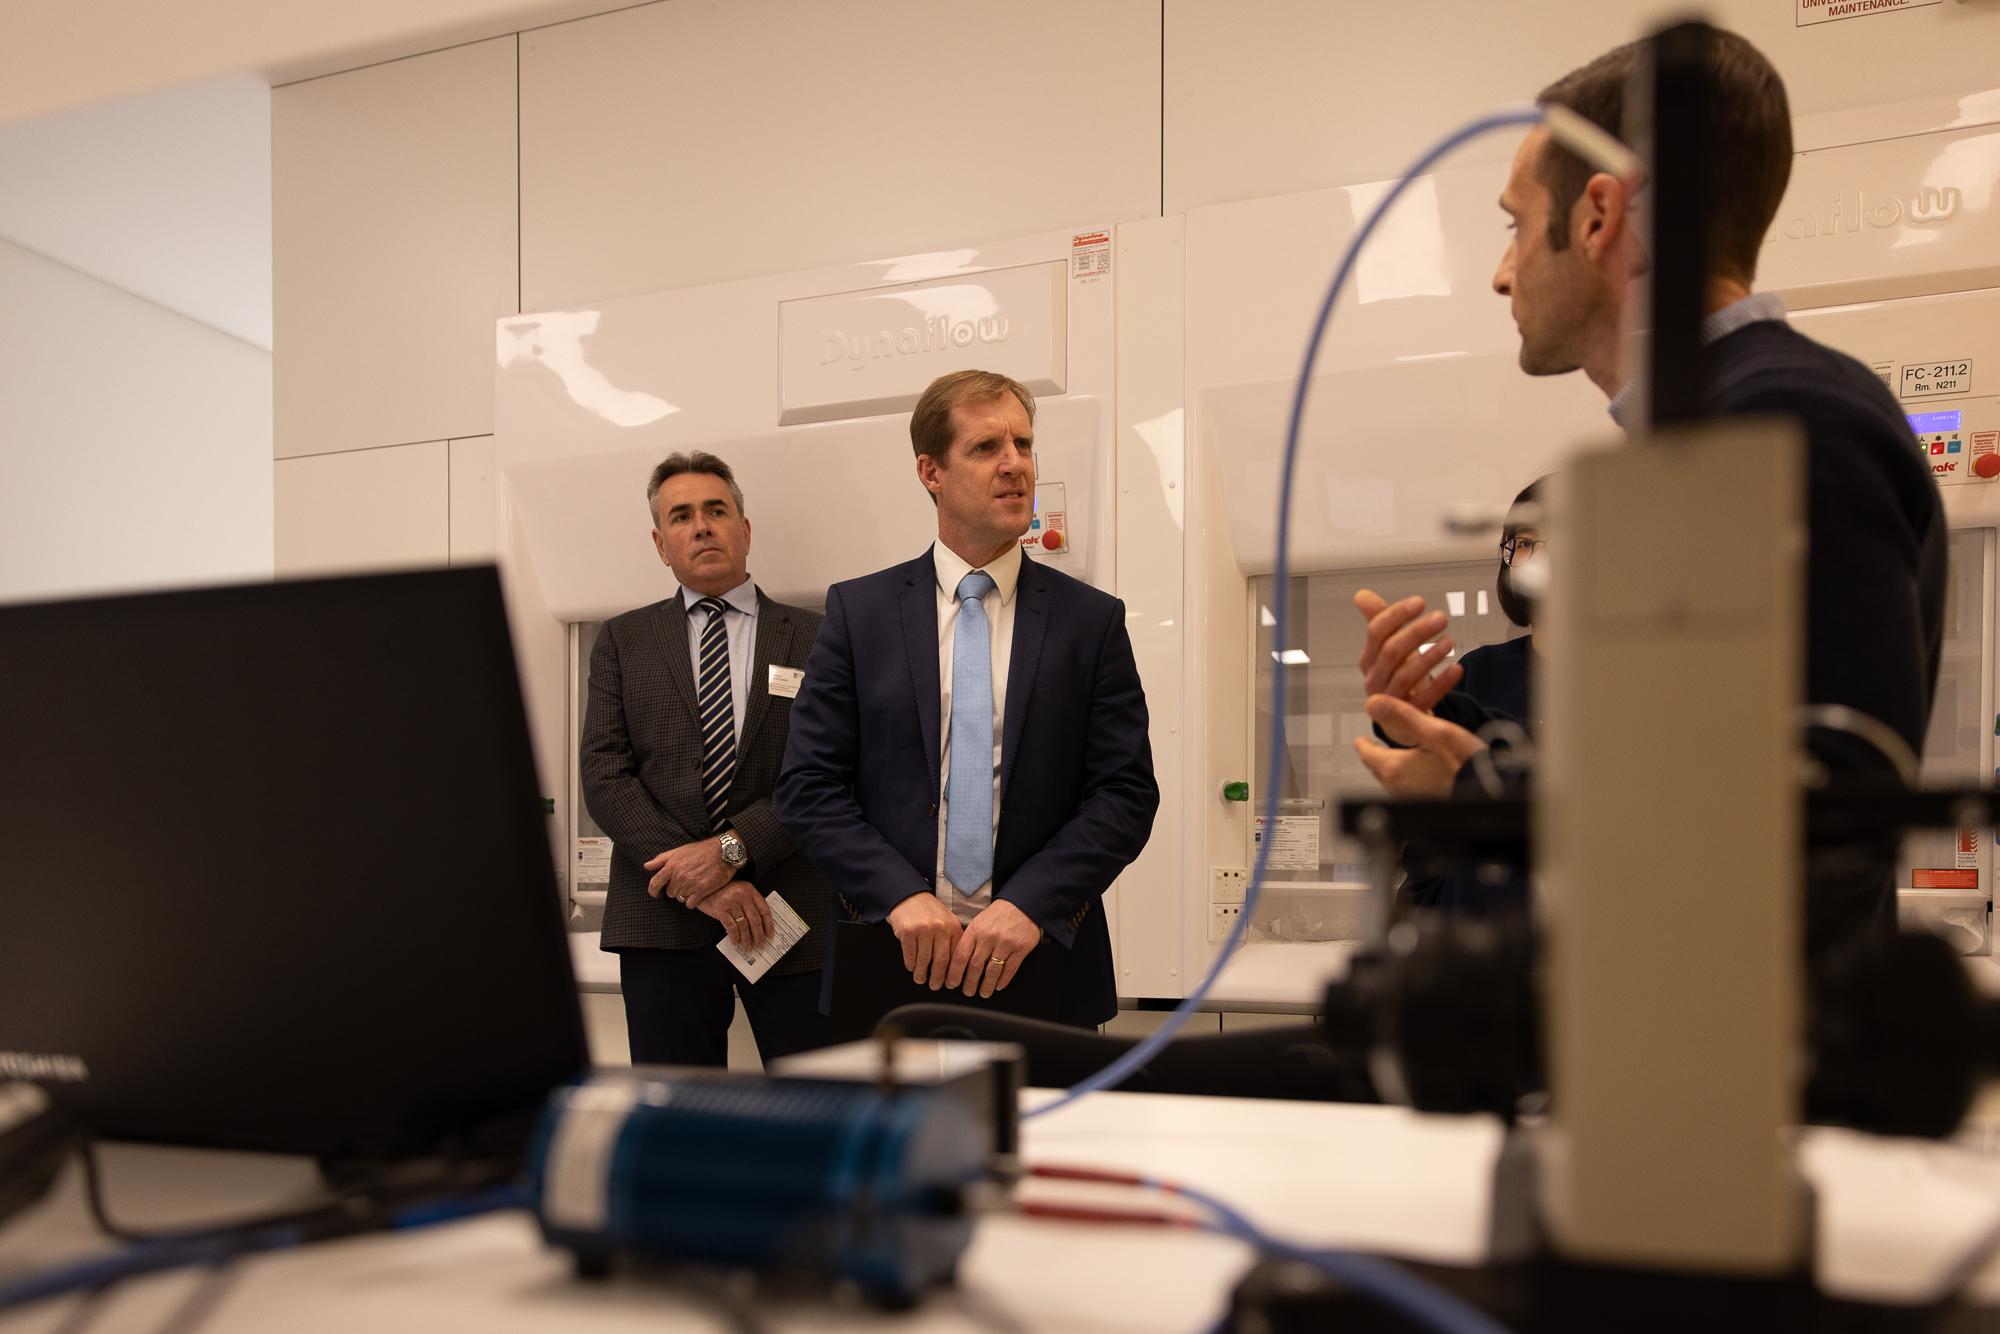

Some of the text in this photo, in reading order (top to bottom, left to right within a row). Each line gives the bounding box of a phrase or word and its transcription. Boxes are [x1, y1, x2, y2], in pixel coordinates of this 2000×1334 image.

[1828, 0, 1910, 17] MAINTENANCE.
[818, 313, 1009, 372] Dynaflow
[1914, 380, 1957, 392] Rm. N211
